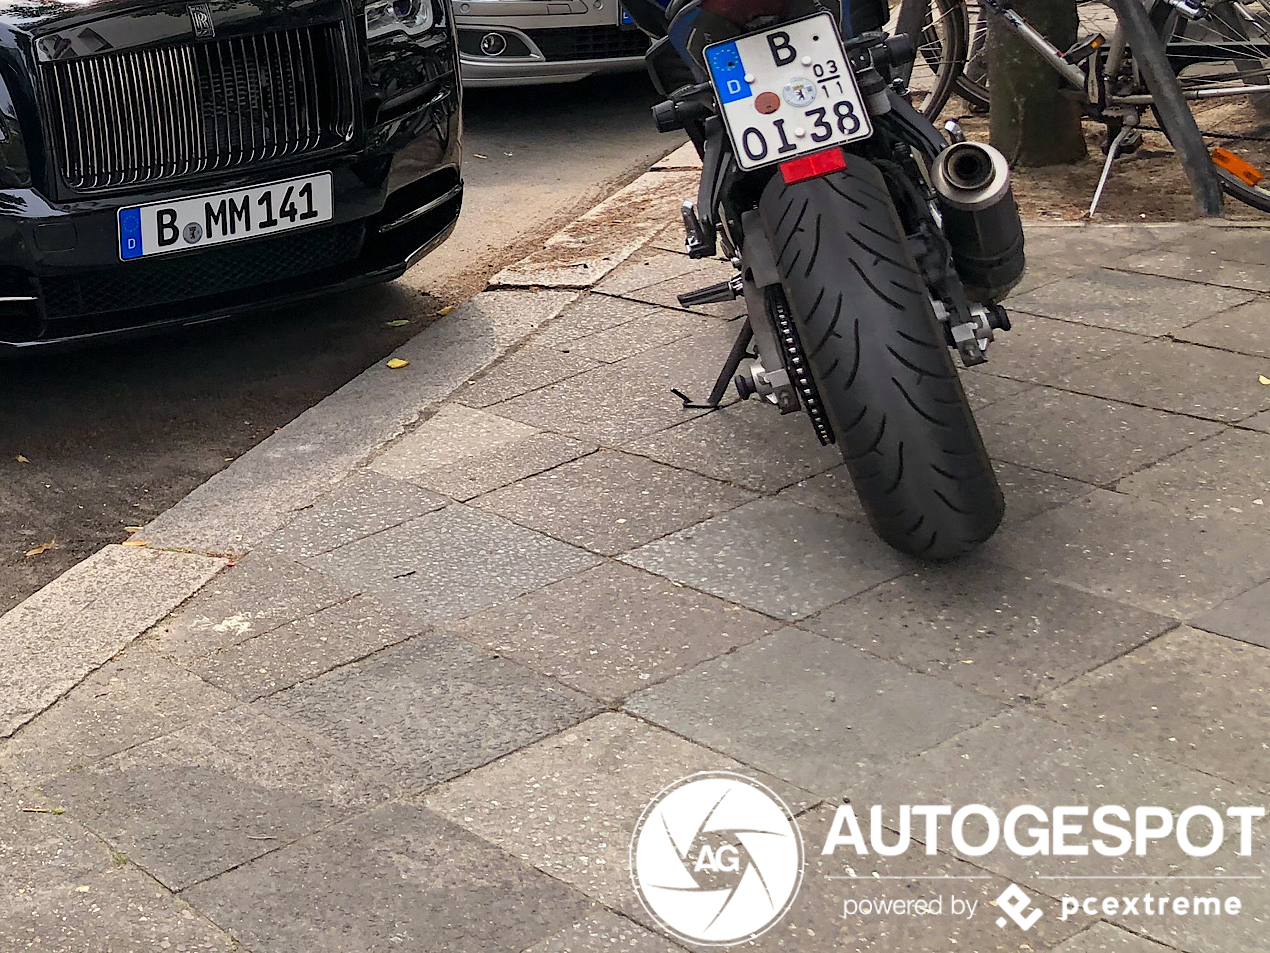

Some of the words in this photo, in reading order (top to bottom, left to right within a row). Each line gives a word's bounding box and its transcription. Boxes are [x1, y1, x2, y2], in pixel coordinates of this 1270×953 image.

[766, 31, 797, 67] B
[813, 59, 839, 77] 03
[726, 79, 742, 95] D
[822, 81, 844, 98] 11
[805, 100, 861, 143] 38
[156, 208, 180, 247] B
